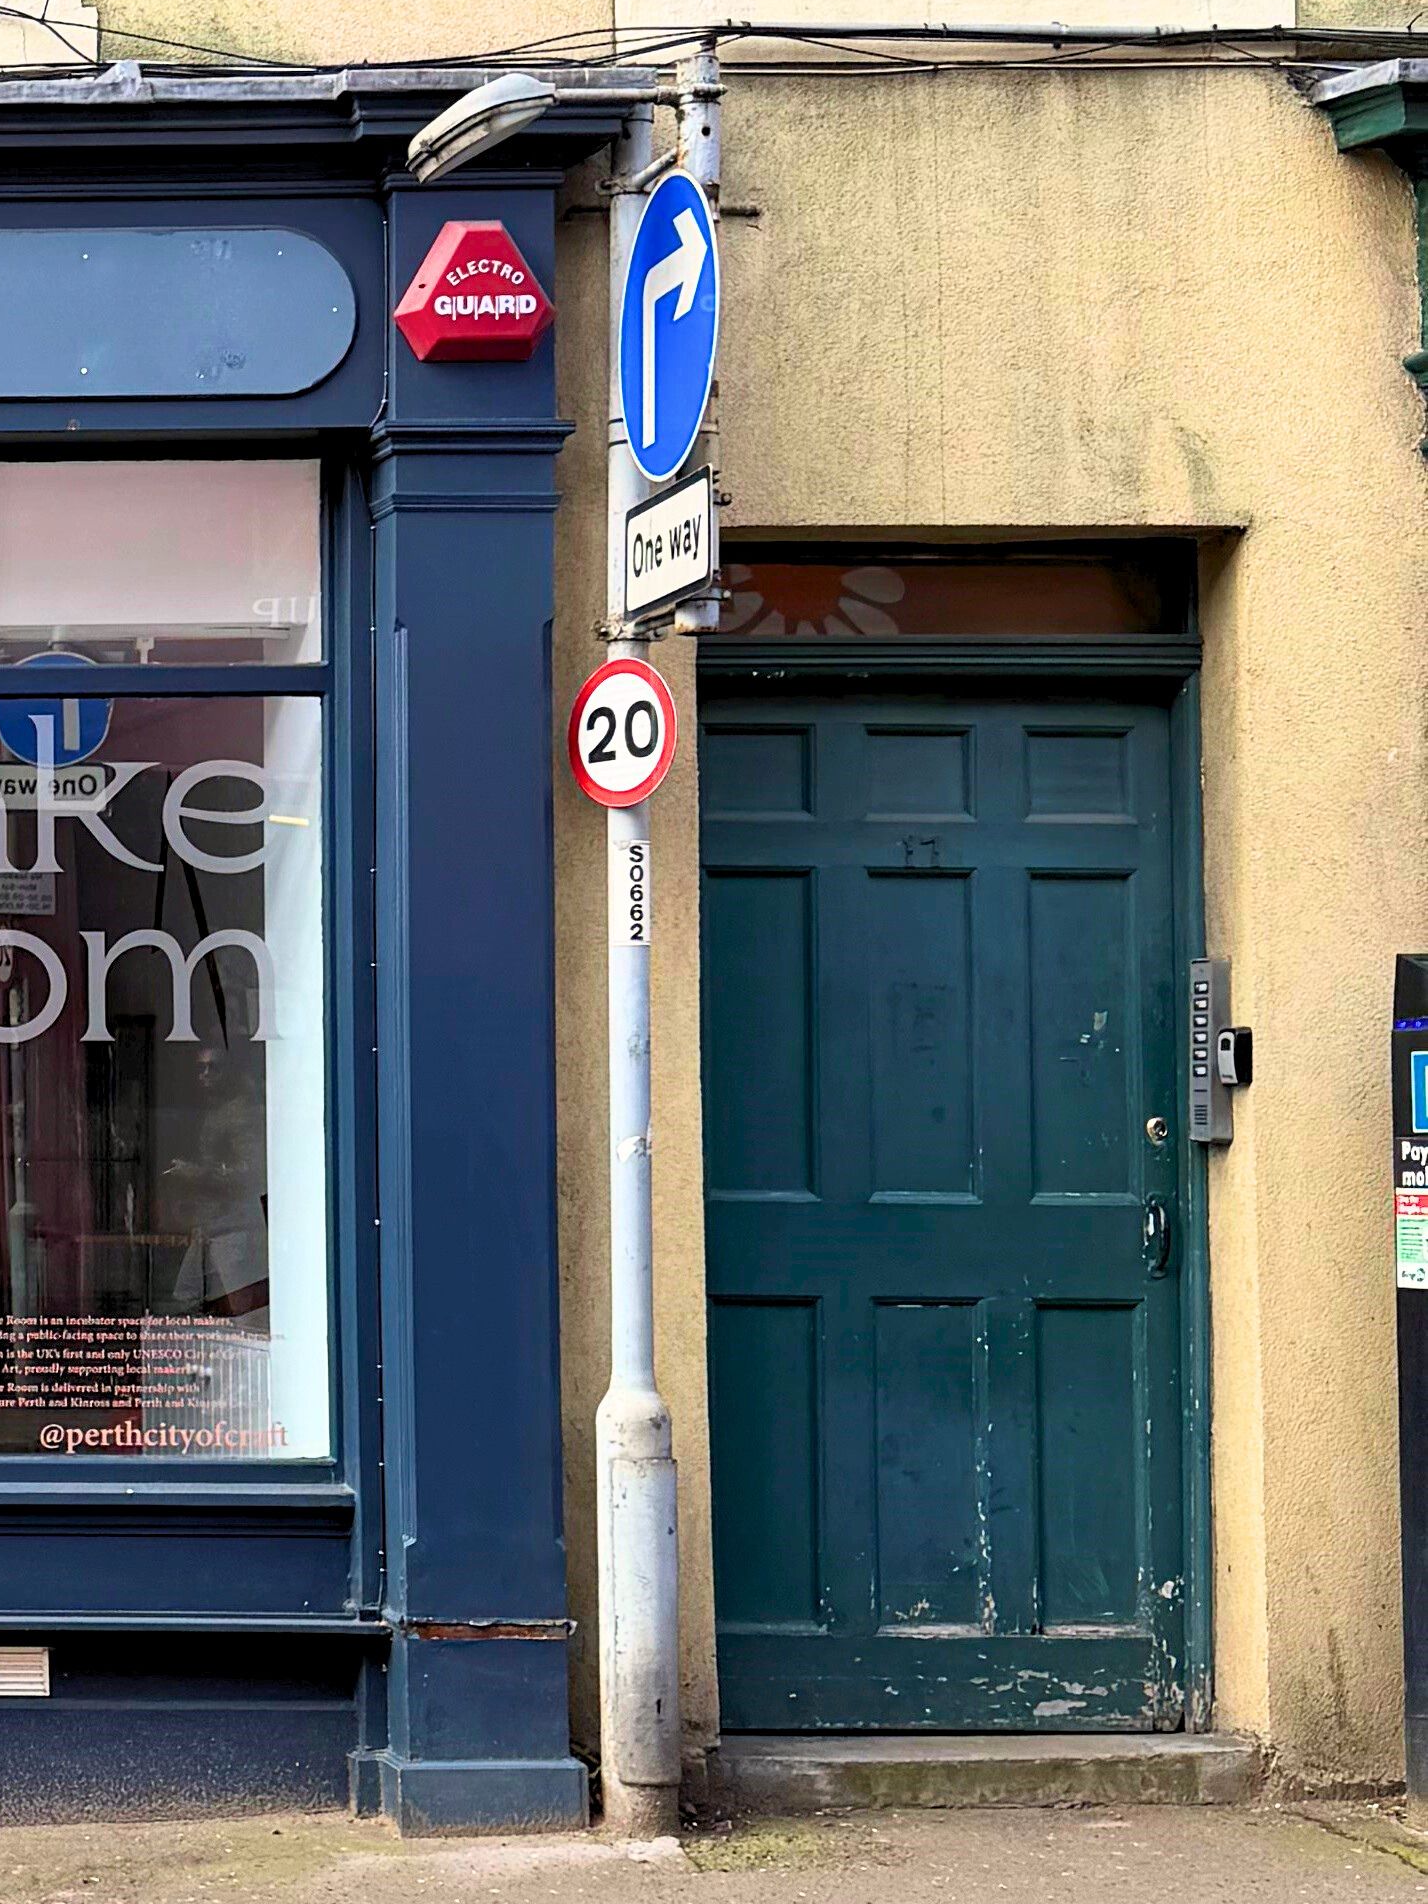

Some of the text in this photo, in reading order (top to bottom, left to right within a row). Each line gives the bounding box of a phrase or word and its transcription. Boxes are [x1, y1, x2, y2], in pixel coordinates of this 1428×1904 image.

[446, 259, 524, 286] ELECTRO
[434, 295, 537, 320] GUARD
[633, 512, 702, 578] One way
[586, 700, 659, 765] 20
[629, 844, 645, 942] S0662
[1401, 1140, 1428, 1166] Pay
[6, 1314, 37, 1326] Room
[39, 1314, 49, 1326] is
[50, 1316, 63, 1326] an
[66, 1315, 116, 1326] incubator
[166, 1315, 191, 1326] local
[96, 1332, 125, 1343] space
[126, 1330, 137, 1340] to
[6, 1348, 15, 1360] is
[17, 1348, 34, 1360] the
[63, 1348, 84, 1360] first
[85, 1348, 105, 1360] and
[107, 1348, 131, 1362] only
[133, 1349, 182, 1360] UNESCO
[24, 1362, 65, 1376] proudly
[67, 1362, 124, 1376] supporting
[126, 1362, 151, 1374] local
[153, 1363, 194, 1374] maker
[7, 1382, 39, 1393] Room
[40, 1382, 49, 1393] is
[51, 1382, 99, 1393] delivered
[101, 1382, 112, 1393] in
[114, 1382, 175, 1396] partnership
[18, 1397, 46, 1408] Perth
[48, 1397, 68, 1408] and
[70, 1397, 110, 1408] Kinross
[112, 1397, 132, 1408] and
[134, 1397, 163, 1408] Perth
[165, 1397, 185, 1408] and
[40, 1420, 289, 1455] @perthcityofcraft
